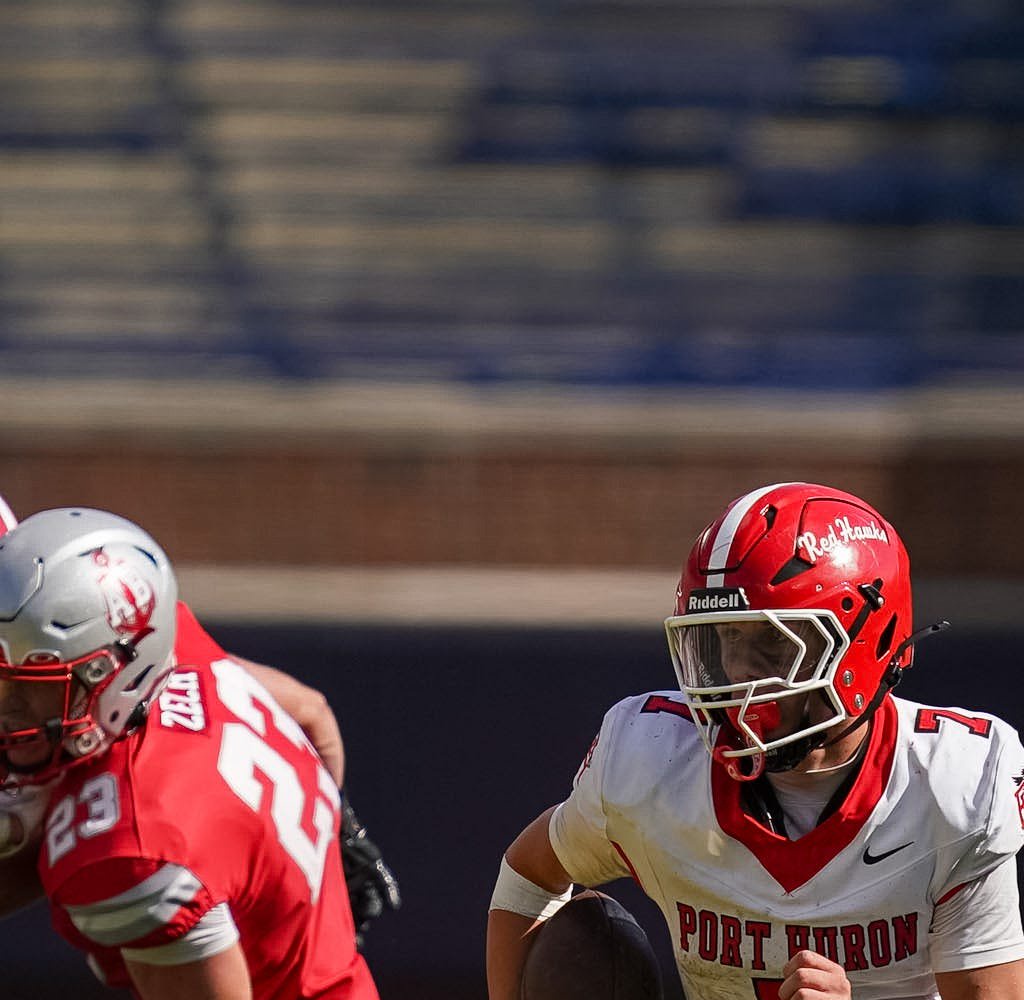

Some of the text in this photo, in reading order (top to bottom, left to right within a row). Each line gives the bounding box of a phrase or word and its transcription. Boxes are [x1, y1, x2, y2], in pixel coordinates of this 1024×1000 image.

[797, 516, 888, 561] Red Hawks
[689, 593, 739, 610] Riddell
[914, 708, 992, 739] 7
[47, 773, 120, 867] 23
[676, 901, 918, 972] PORT HURON
